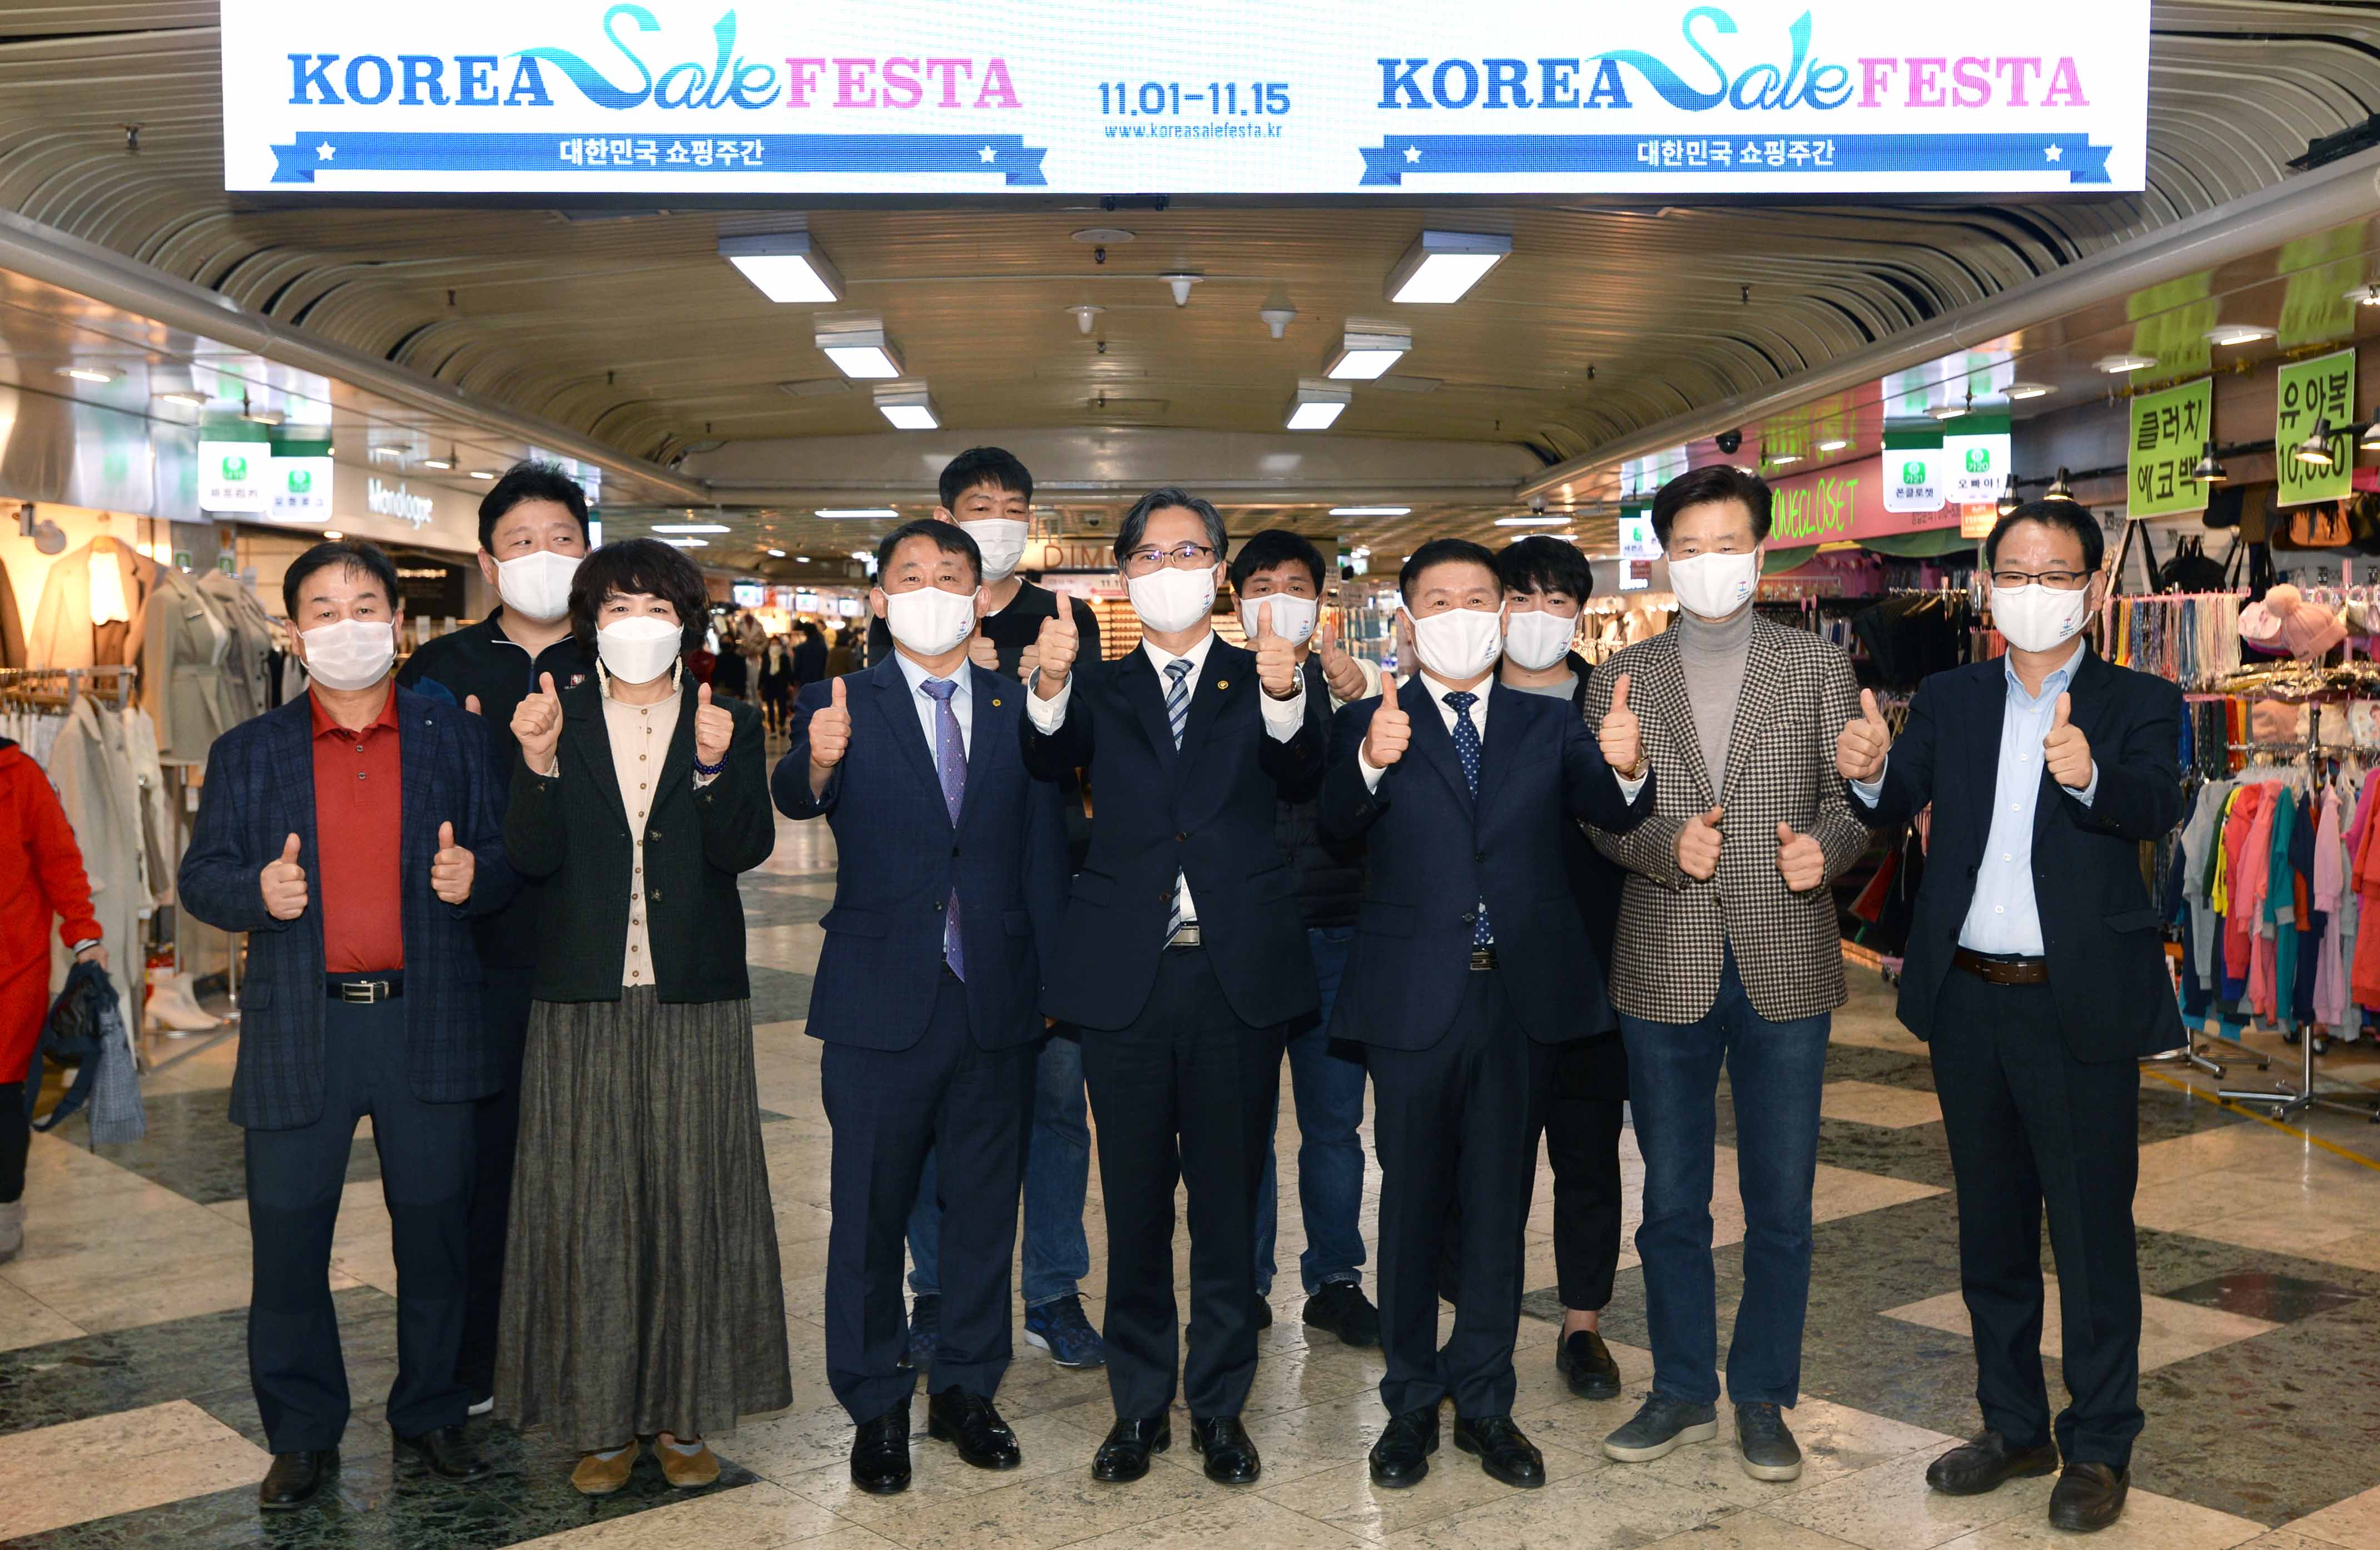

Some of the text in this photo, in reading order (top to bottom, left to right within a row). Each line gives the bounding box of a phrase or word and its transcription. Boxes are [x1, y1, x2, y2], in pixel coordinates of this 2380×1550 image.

[286, 3, 1023, 110] KOREA Sale FESTA
[1376, 6, 2090, 112] KOREA Sale FESTA
[1098, 81, 1291, 116] 11.01-11.15
[559, 138, 765, 166] 대한민국 쇼핑주간
[1104, 122, 1283, 139] www.koreasalefesta.kr
[1637, 139, 1836, 167] 대한민국 쇼핑주간
[2279, 370, 2349, 430] 유아복
[2138, 399, 2202, 452] 클러치
[2137, 455, 2198, 503] 에코백
[1771, 476, 1860, 542] ONECLOSET
